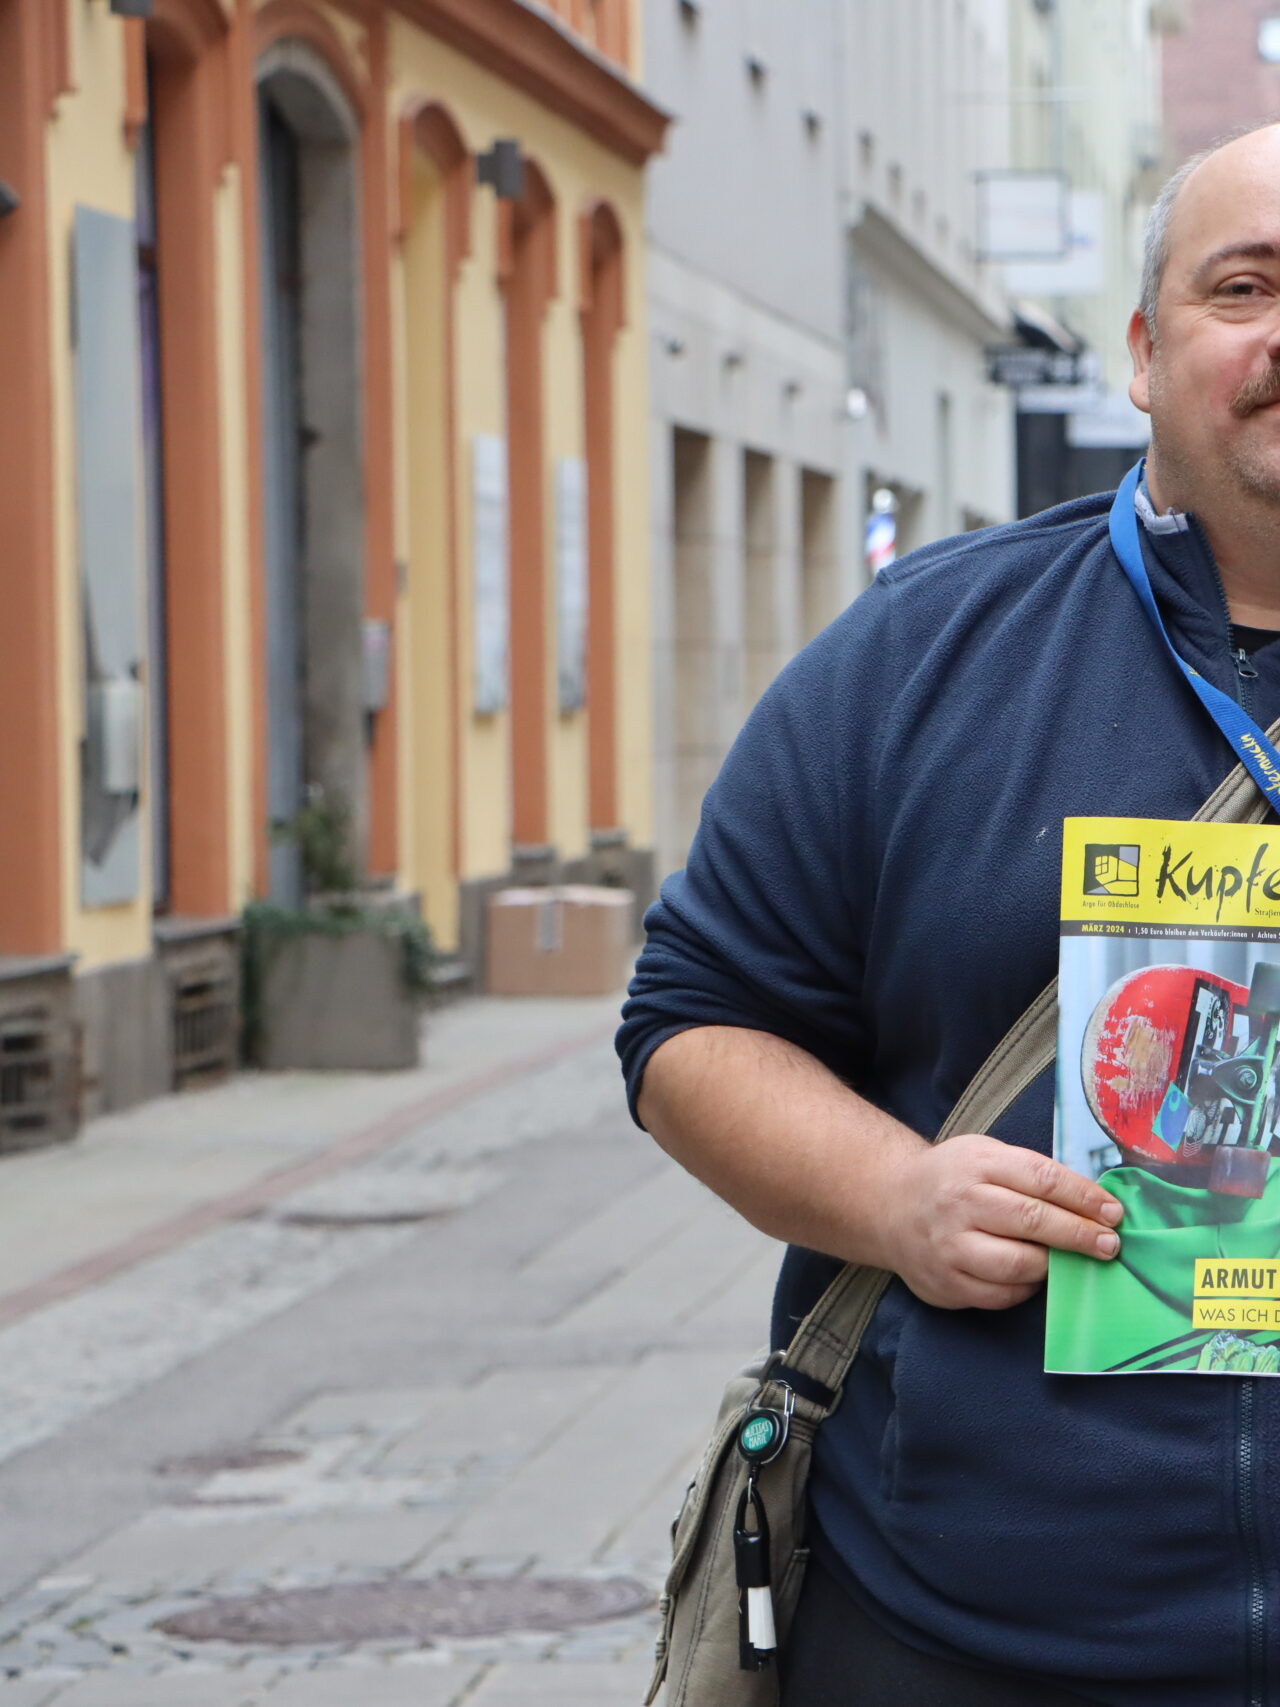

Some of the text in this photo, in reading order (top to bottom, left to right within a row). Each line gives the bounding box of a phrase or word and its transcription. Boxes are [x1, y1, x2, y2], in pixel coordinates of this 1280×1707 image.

[1082, 900, 1140, 909] Arge für Obdachlose
[1081, 922, 1104, 933] MÄRZ
[1106, 924, 1125, 934] 2024
[1134, 927, 1149, 936] 1,50
[1150, 928, 1163, 936] Euro
[1164, 928, 1187, 937] bleiben
[1188, 929, 1199, 937] den
[1200, 929, 1248, 939] Verkäufer:innen
[1257, 931, 1277, 940] Achten
[1200, 1267, 1277, 1290] ARMUT
[1199, 1307, 1236, 1322] WAS
[1241, 1308, 1269, 1324] ICH
